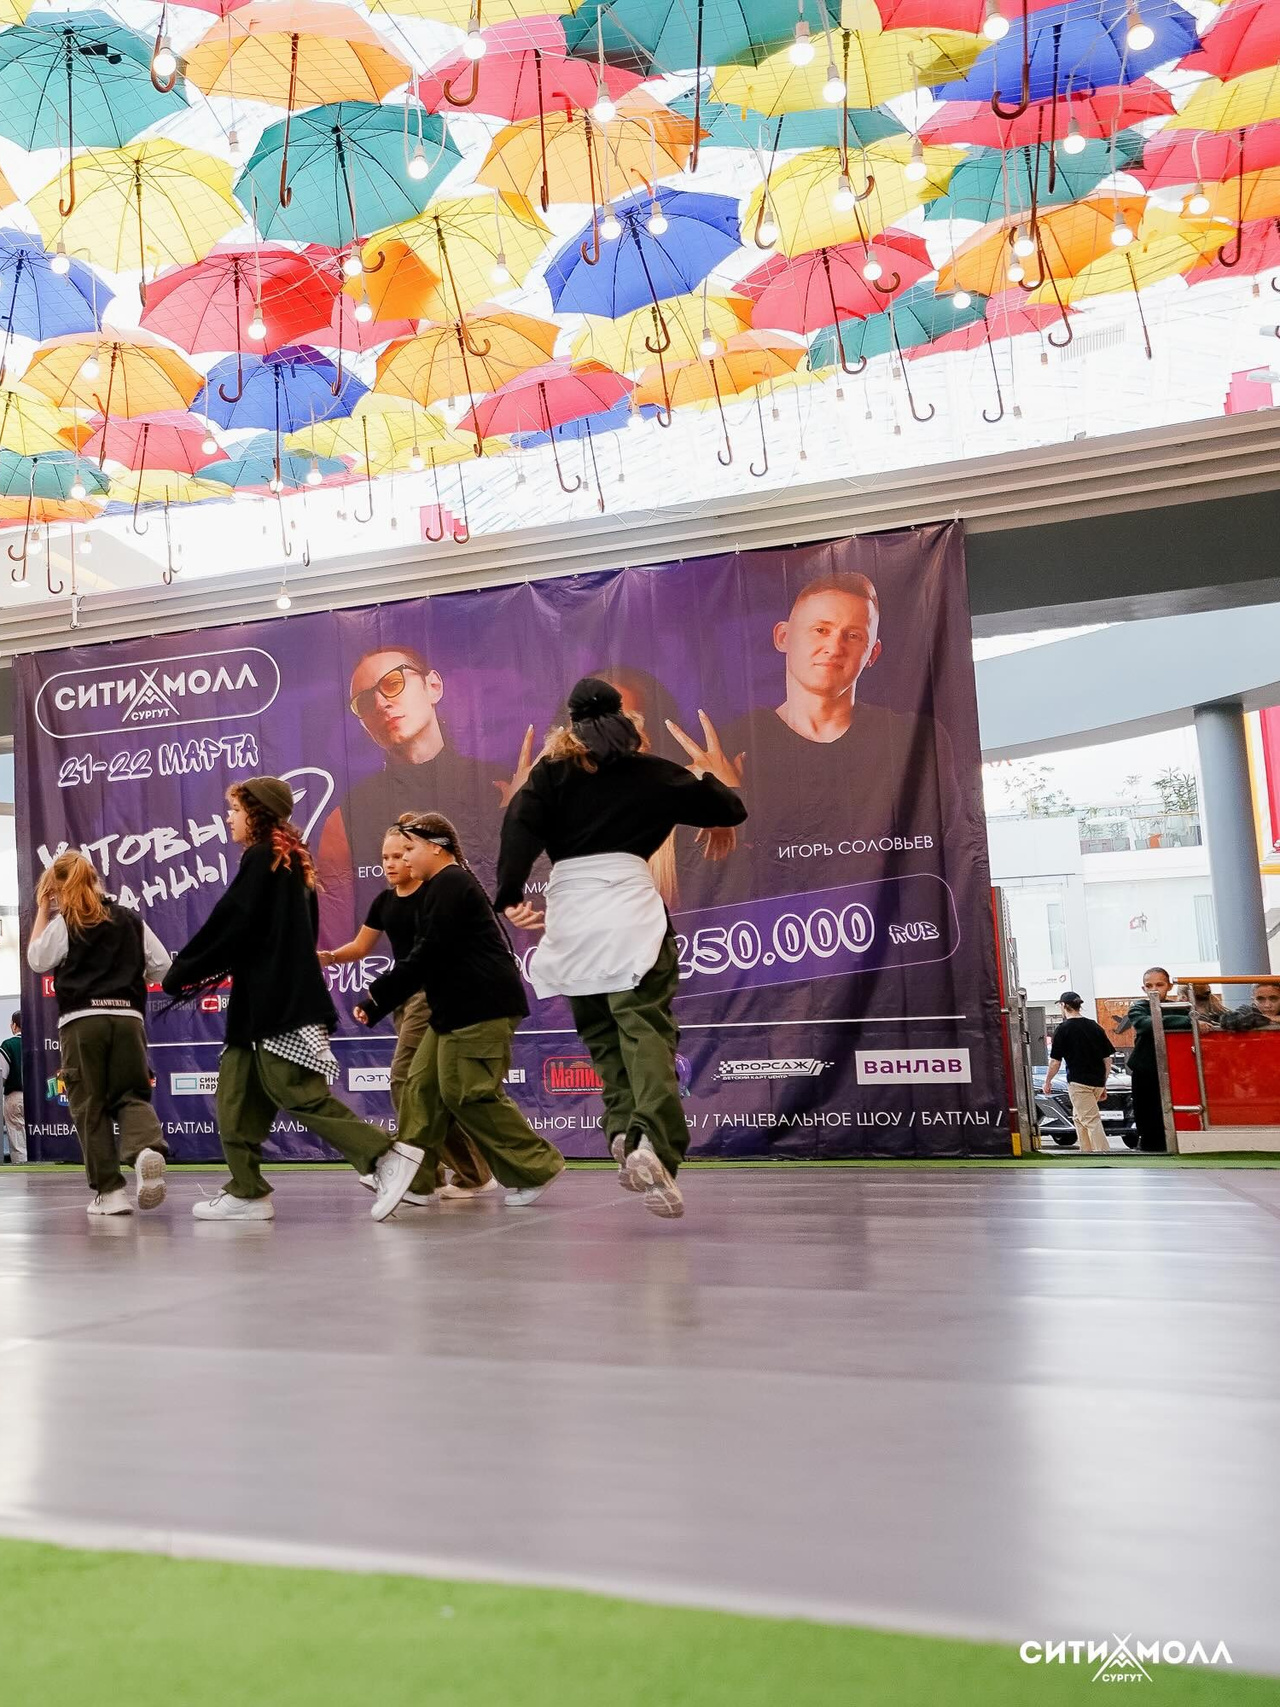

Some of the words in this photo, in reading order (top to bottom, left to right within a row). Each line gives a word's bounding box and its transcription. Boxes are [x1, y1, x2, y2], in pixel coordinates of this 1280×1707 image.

[131, 708, 170, 721] СУРГУТ
[57, 749, 153, 787] 21-22
[158, 733, 259, 776] МАРТА
[778, 843, 833, 859] ИГОРЬ
[838, 835, 934, 855] СОЛОВЬЕВ
[105, 852, 228, 912] АНЦЫ
[889, 921, 939, 944] RUB
[734, 1060, 809, 1074] ФОРСАЖ
[863, 1058, 963, 1075] ванлав
[167, 1121, 214, 1135] БАТТЛЫ
[713, 1113, 851, 1128] ТАНЦЕВАЛЬНОЕ
[857, 1111, 903, 1126] ШОУ
[922, 1110, 990, 1126] БАТТЛЫ
